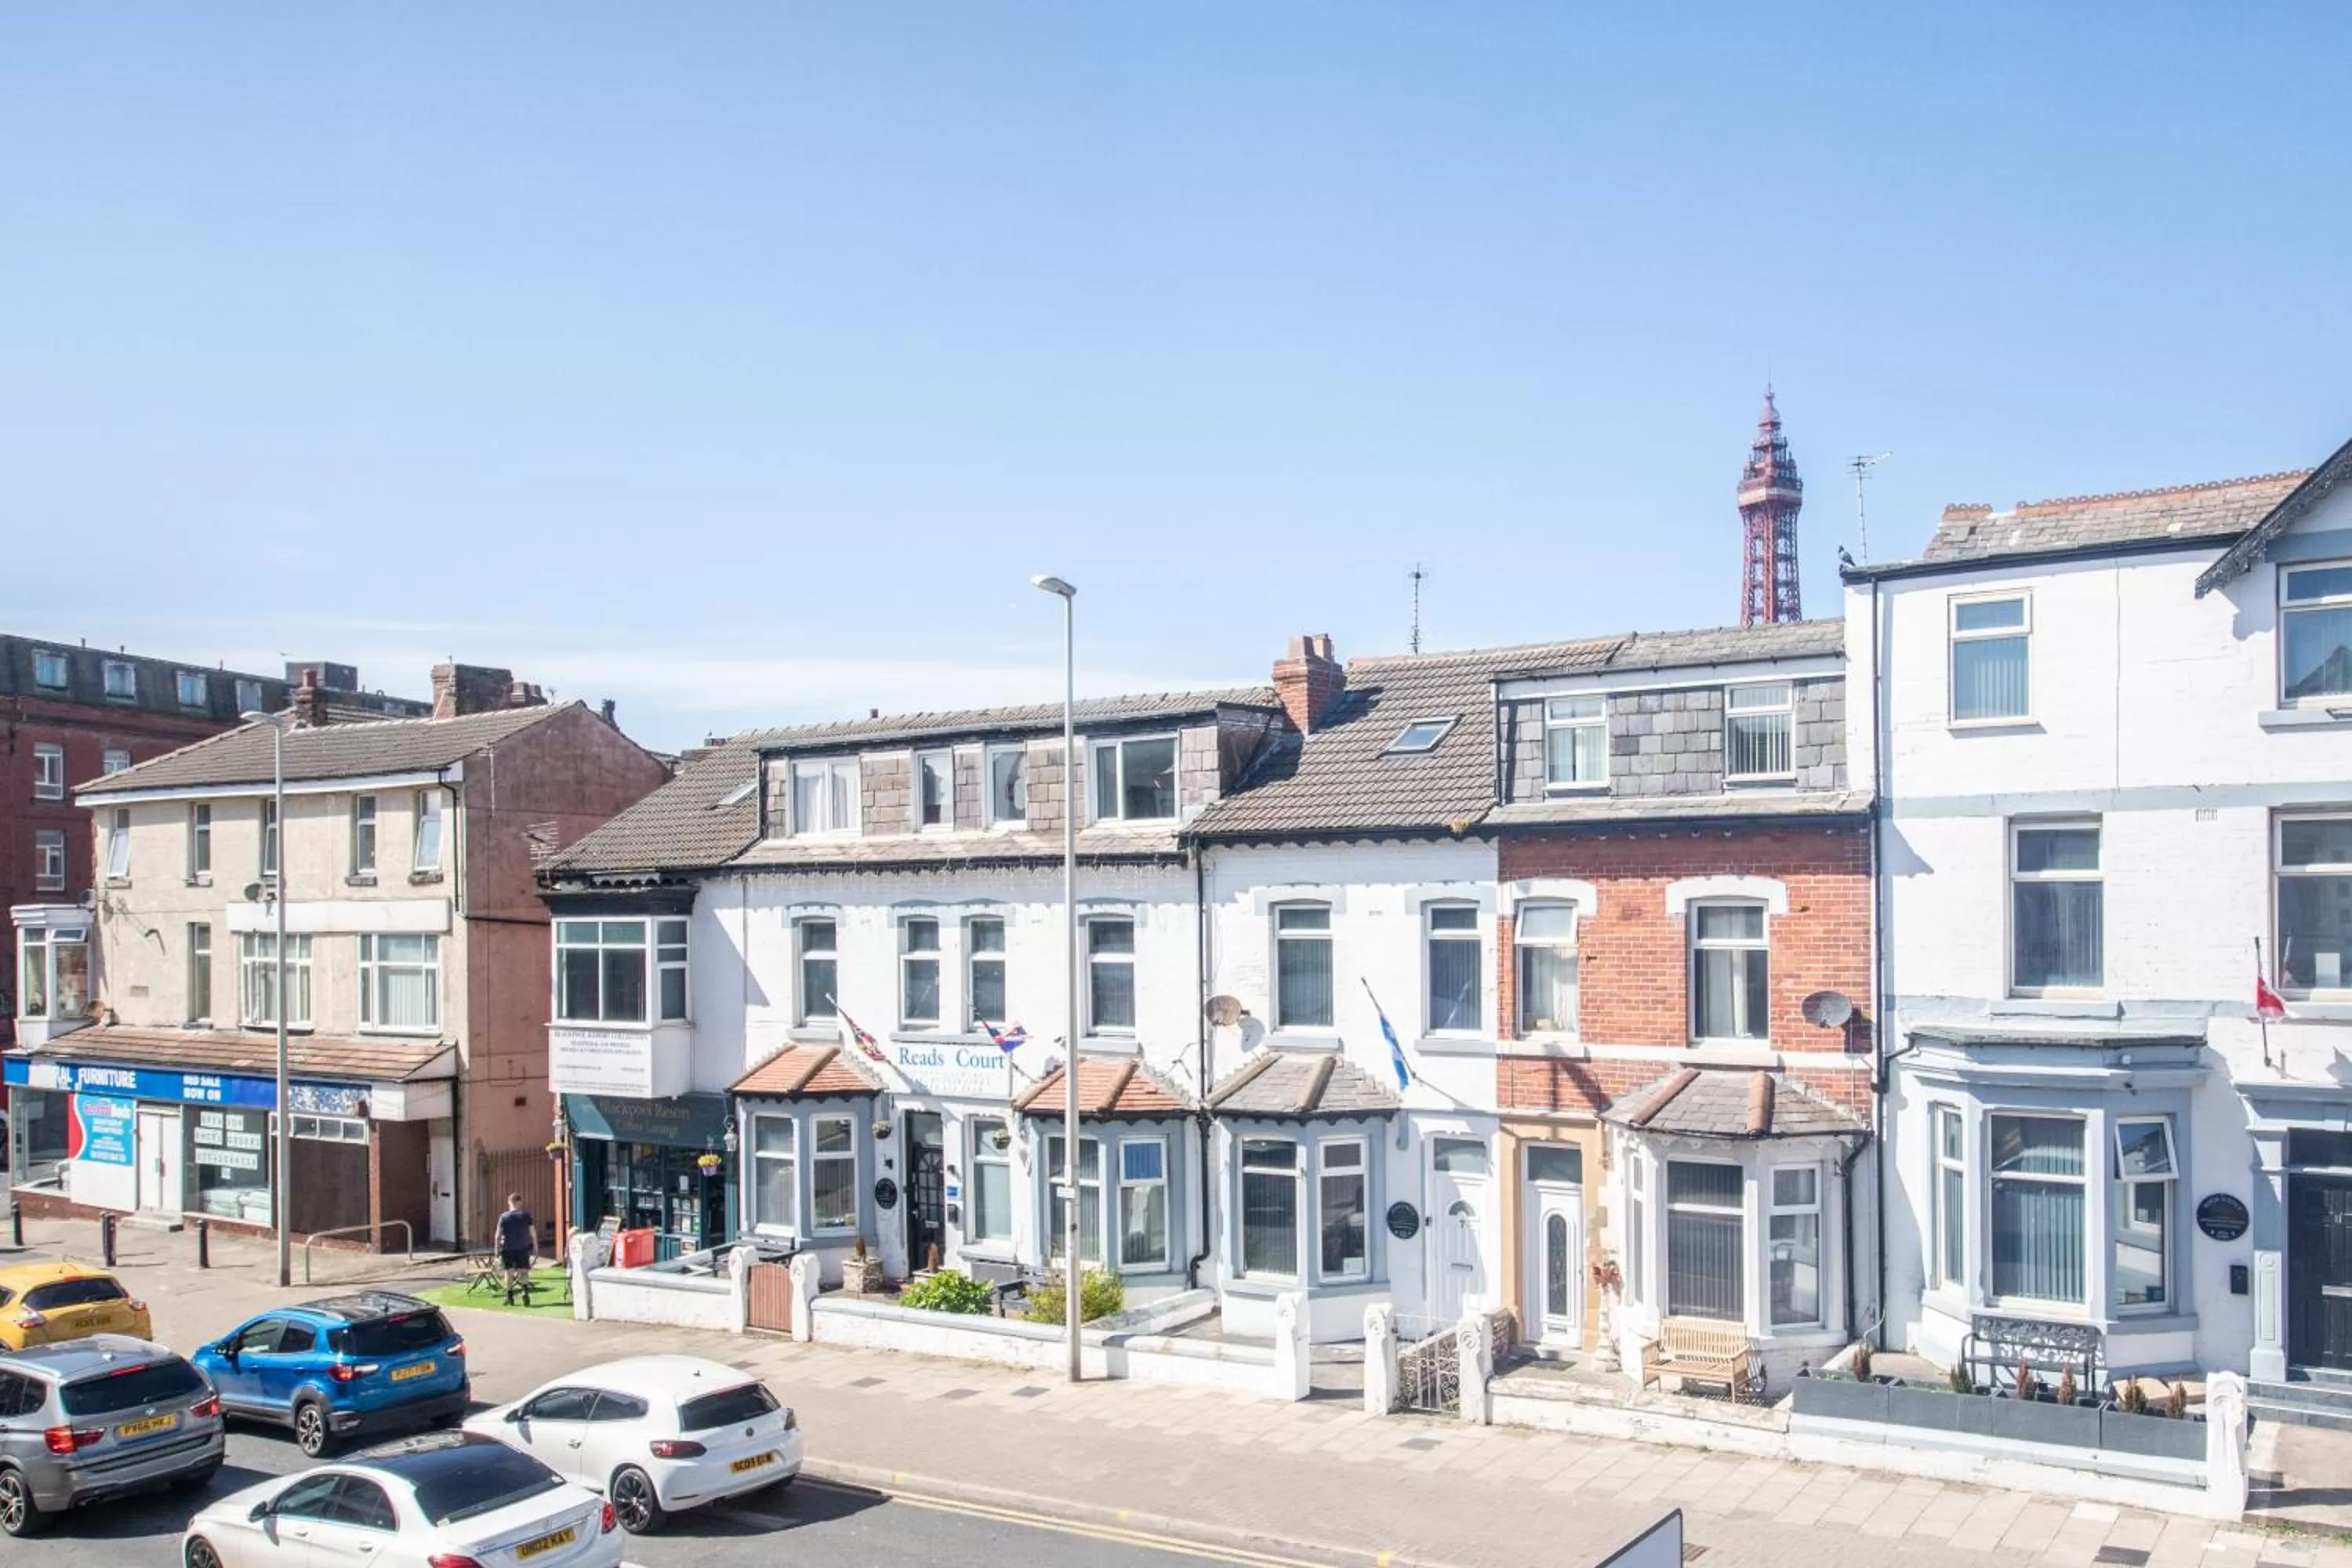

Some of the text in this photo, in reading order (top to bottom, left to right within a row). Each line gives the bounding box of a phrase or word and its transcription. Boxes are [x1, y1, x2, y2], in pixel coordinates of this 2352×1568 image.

[898, 1047, 1005, 1069] Reads Court
[78, 1067, 137, 1089] FURNITURE
[183, 1087, 221, 1102] NOW ON
